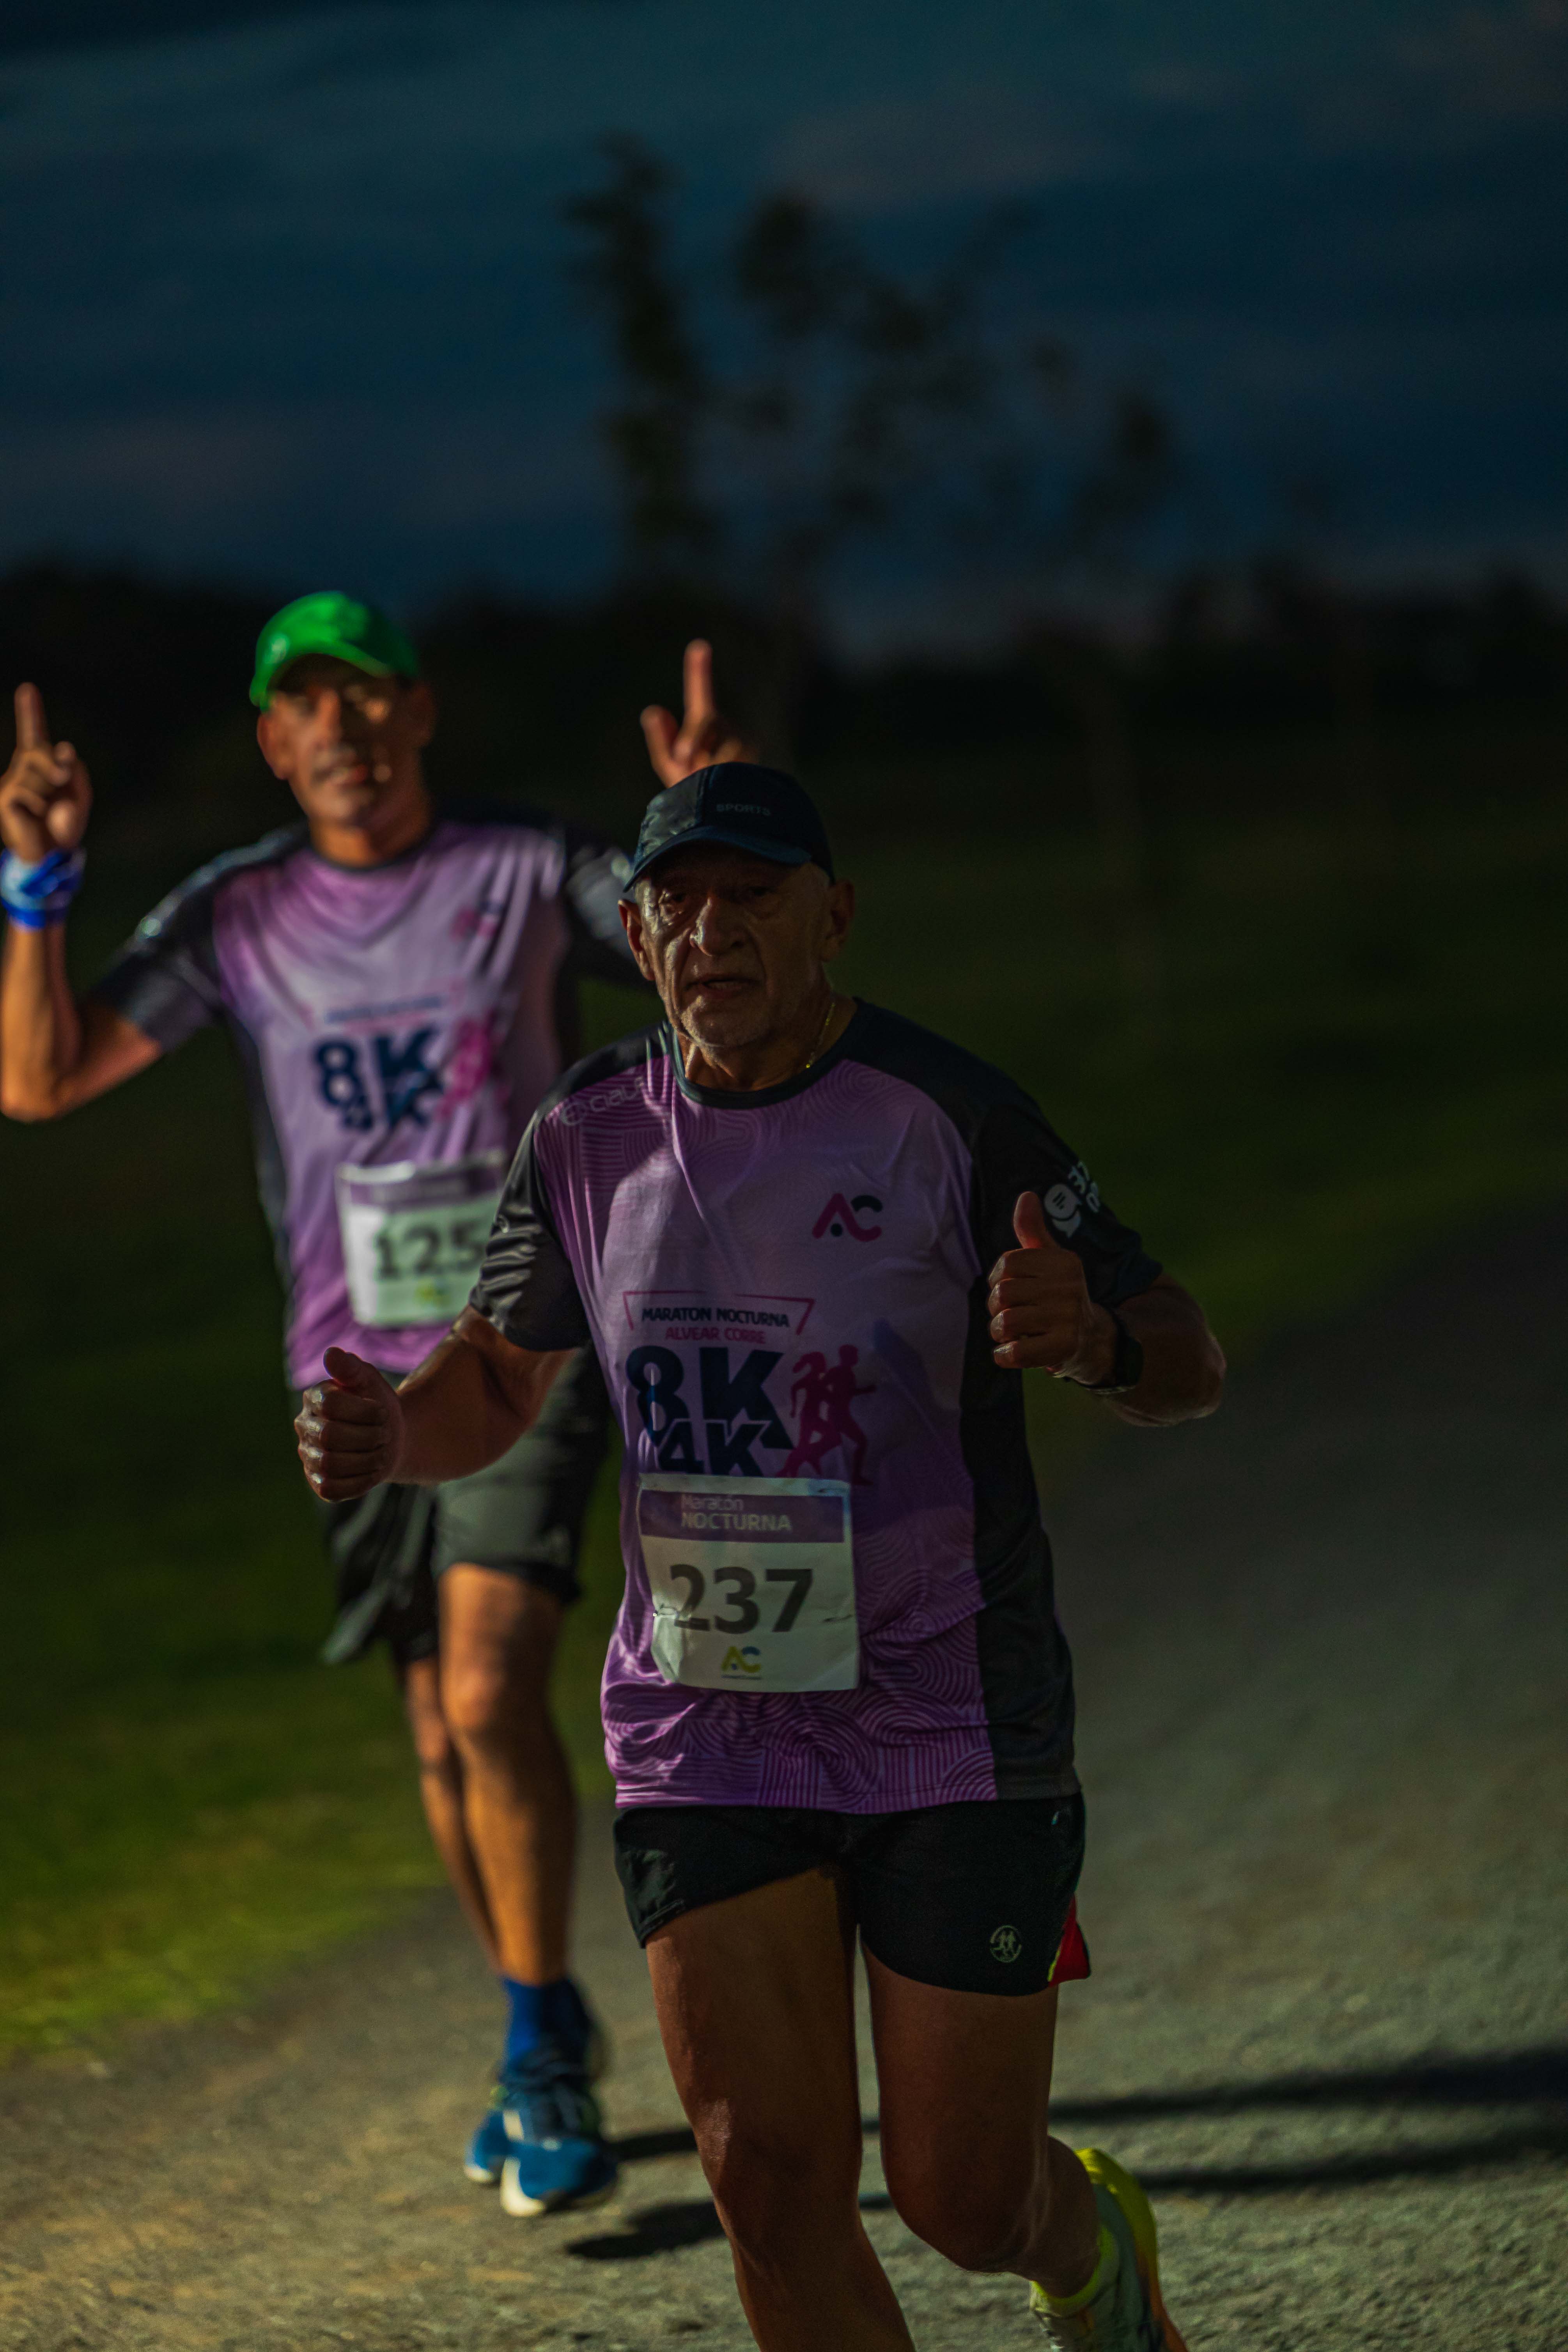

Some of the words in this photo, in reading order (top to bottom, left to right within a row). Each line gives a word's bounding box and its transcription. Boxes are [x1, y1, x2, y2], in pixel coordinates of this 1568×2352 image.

[716, 803, 771, 816] SPORTS
[812, 1193, 883, 1242] AC
[642, 1307, 711, 1322] MARATON
[717, 1308, 789, 1327] NOCTURNA
[665, 1327, 721, 1341] ALVEAR
[725, 1328, 765, 1344] CORRE
[626, 1345, 795, 1450] 8K
[657, 1421, 764, 1477] 4K
[682, 1513, 793, 1531] NOCTURNA
[670, 1564, 813, 1635] 237
[721, 1646, 762, 1673] AC
